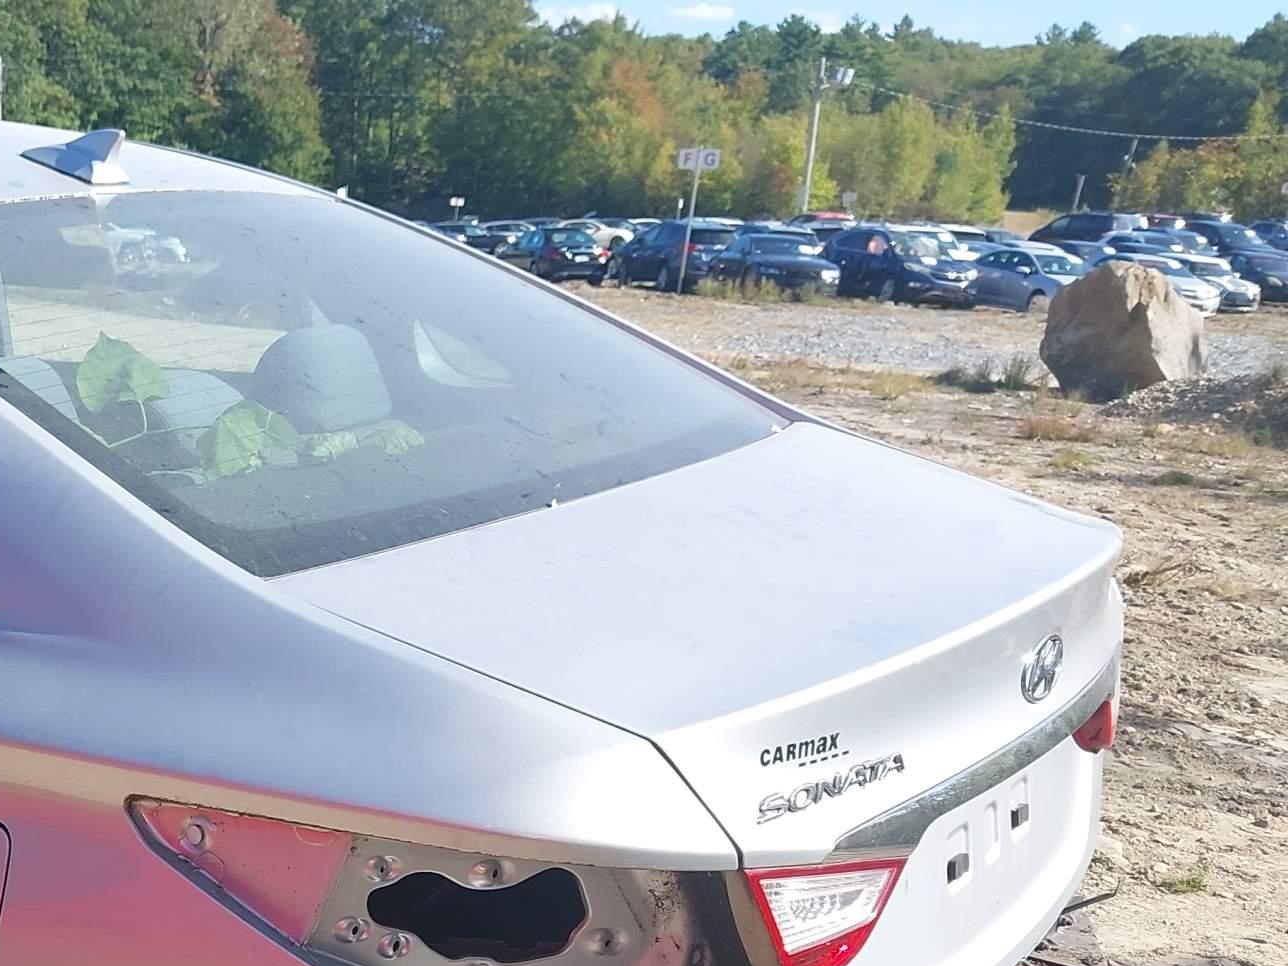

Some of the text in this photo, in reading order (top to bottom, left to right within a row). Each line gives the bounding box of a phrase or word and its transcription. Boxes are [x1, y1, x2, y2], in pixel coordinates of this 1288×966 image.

[683, 152, 693, 166] F
[704, 151, 717, 166] G
[757, 752, 905, 824] SONATA
